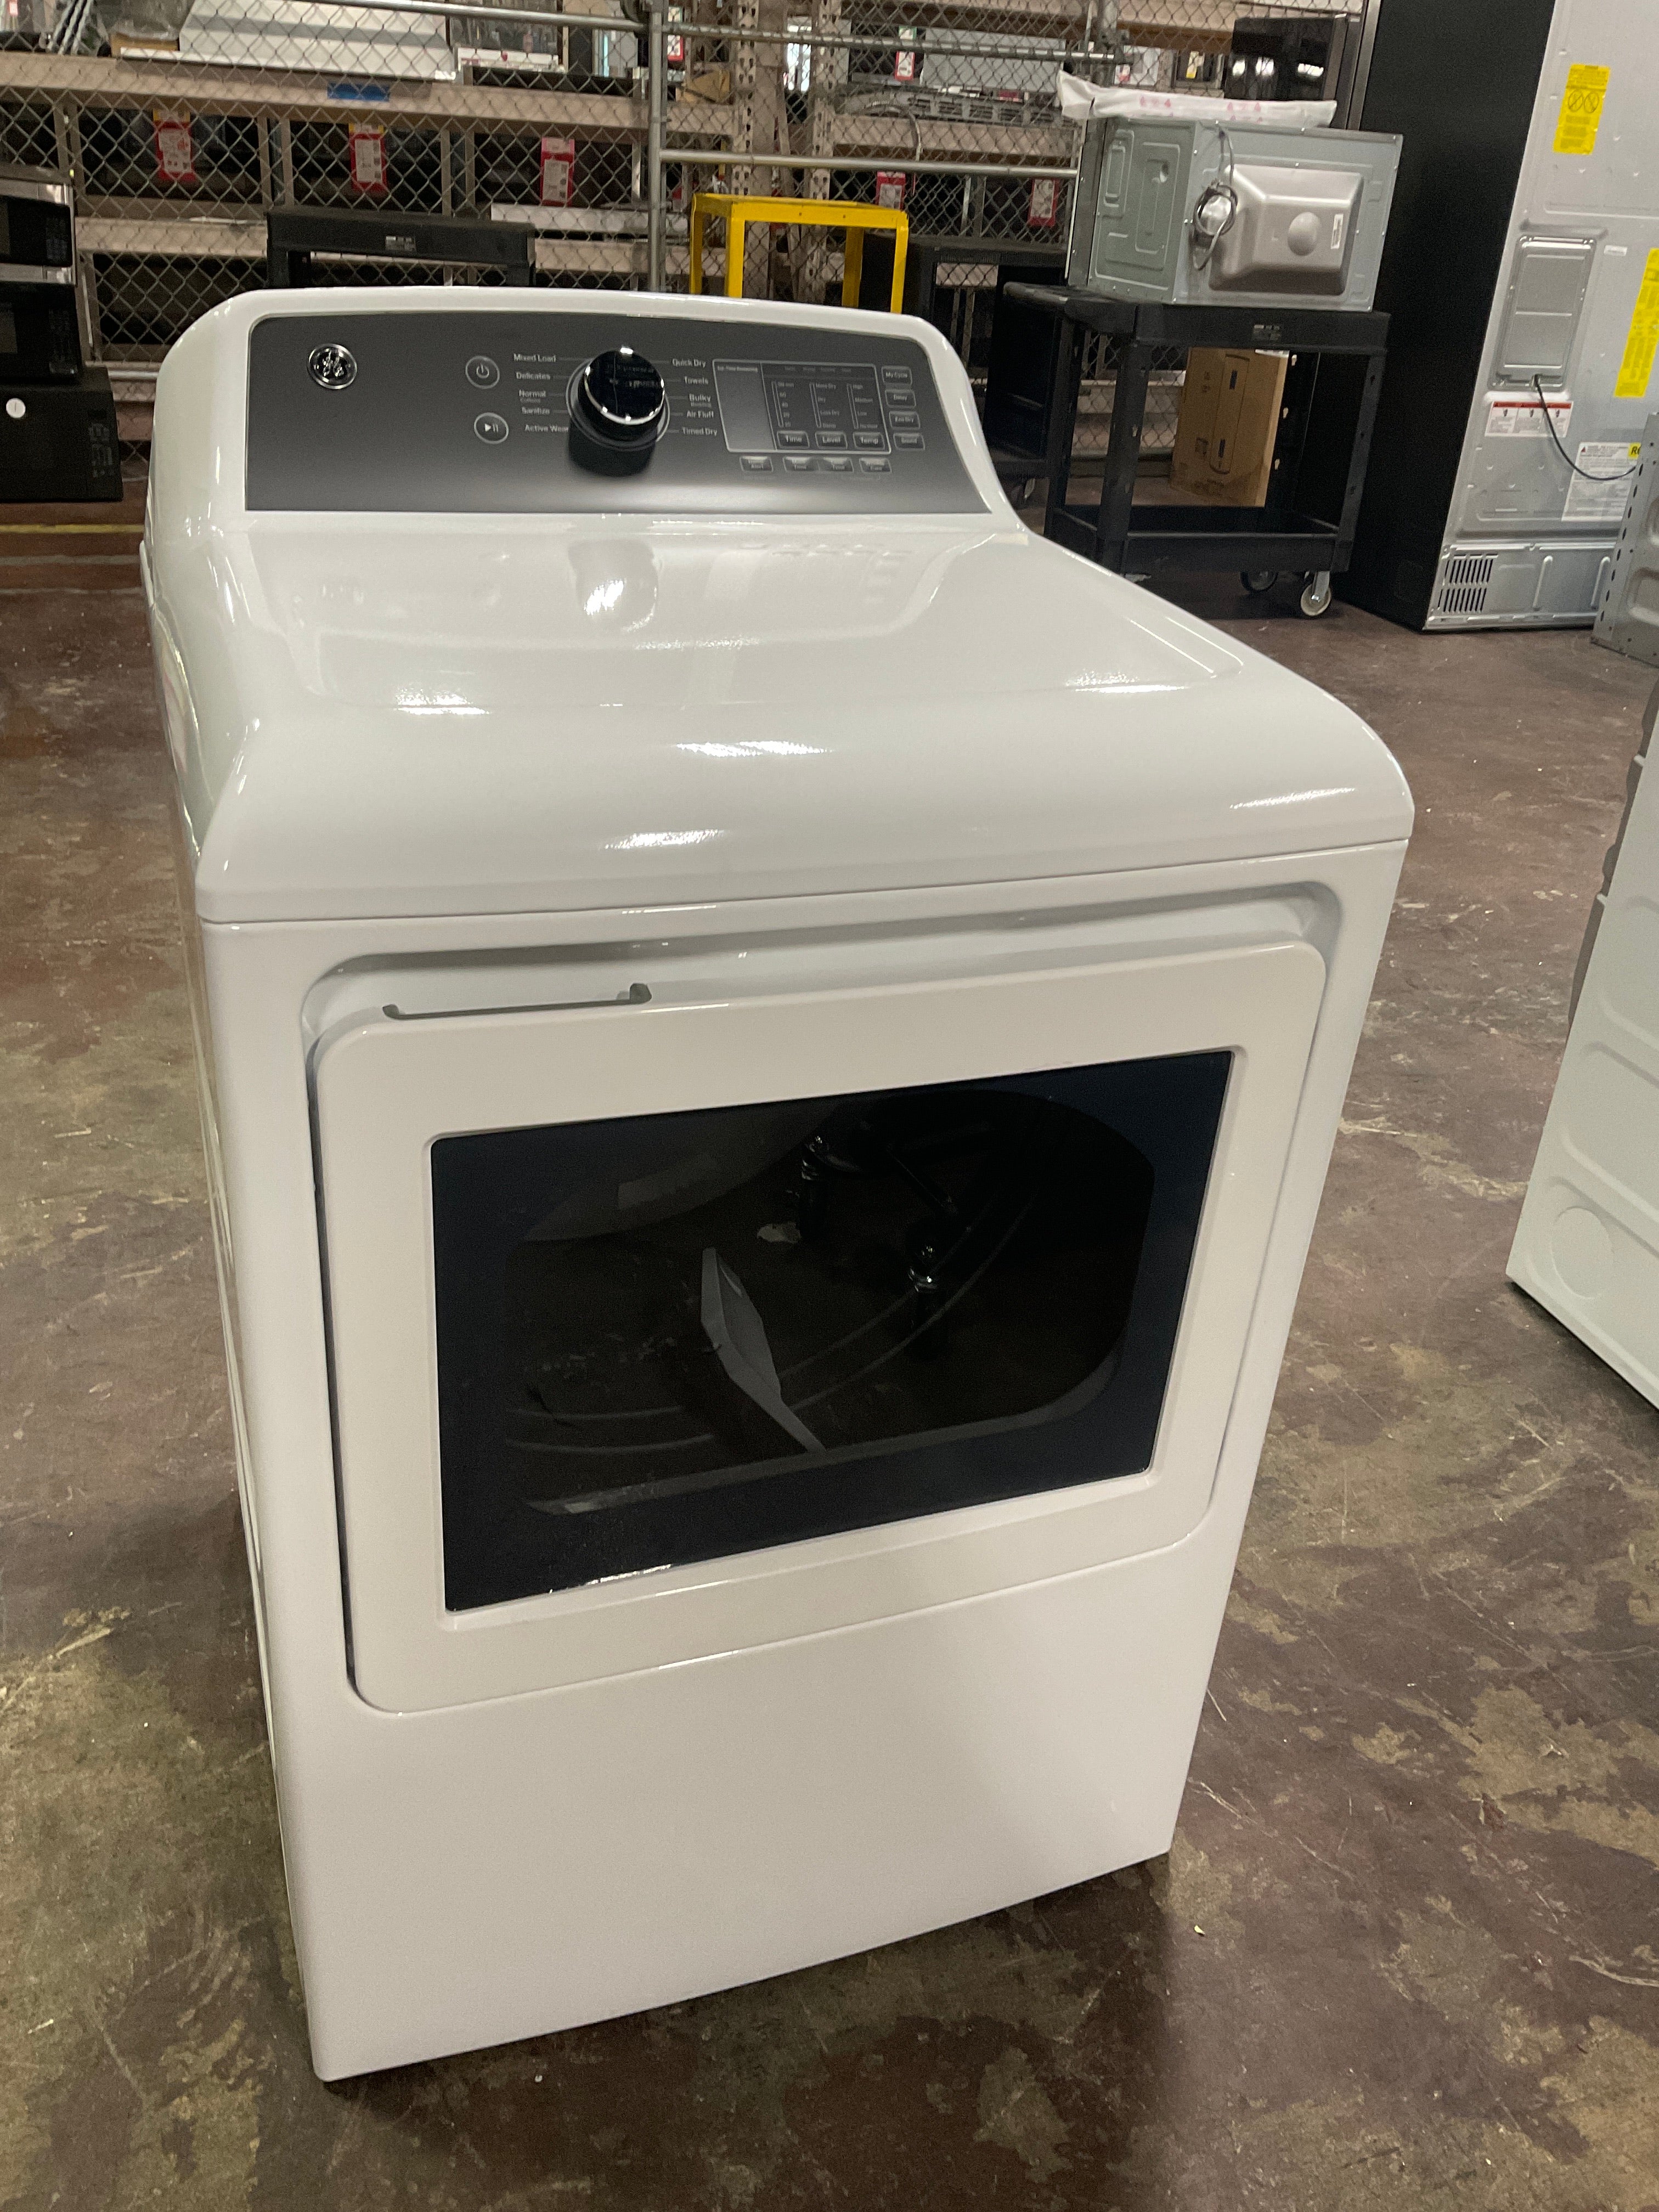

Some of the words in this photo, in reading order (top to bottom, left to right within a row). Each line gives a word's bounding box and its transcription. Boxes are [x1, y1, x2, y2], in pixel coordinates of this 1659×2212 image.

[514, 353, 536, 362] Mixed
[538, 354, 556, 363] Load
[672, 358, 692, 367] Quick
[693, 359, 706, 368] Dry
[516, 371, 551, 380] Delicates
[685, 376, 709, 385] Towels
[518, 389, 546, 398] Normal
[689, 393, 711, 402] Bulky
[521, 407, 550, 415] Sanitize
[698, 410, 714, 419] Fluff
[525, 424, 549, 432] Active
[682, 427, 704, 435] Timed
[705, 427, 718, 437] Dry
[822, 435, 841, 443] Level
[861, 437, 879, 445] Temp
